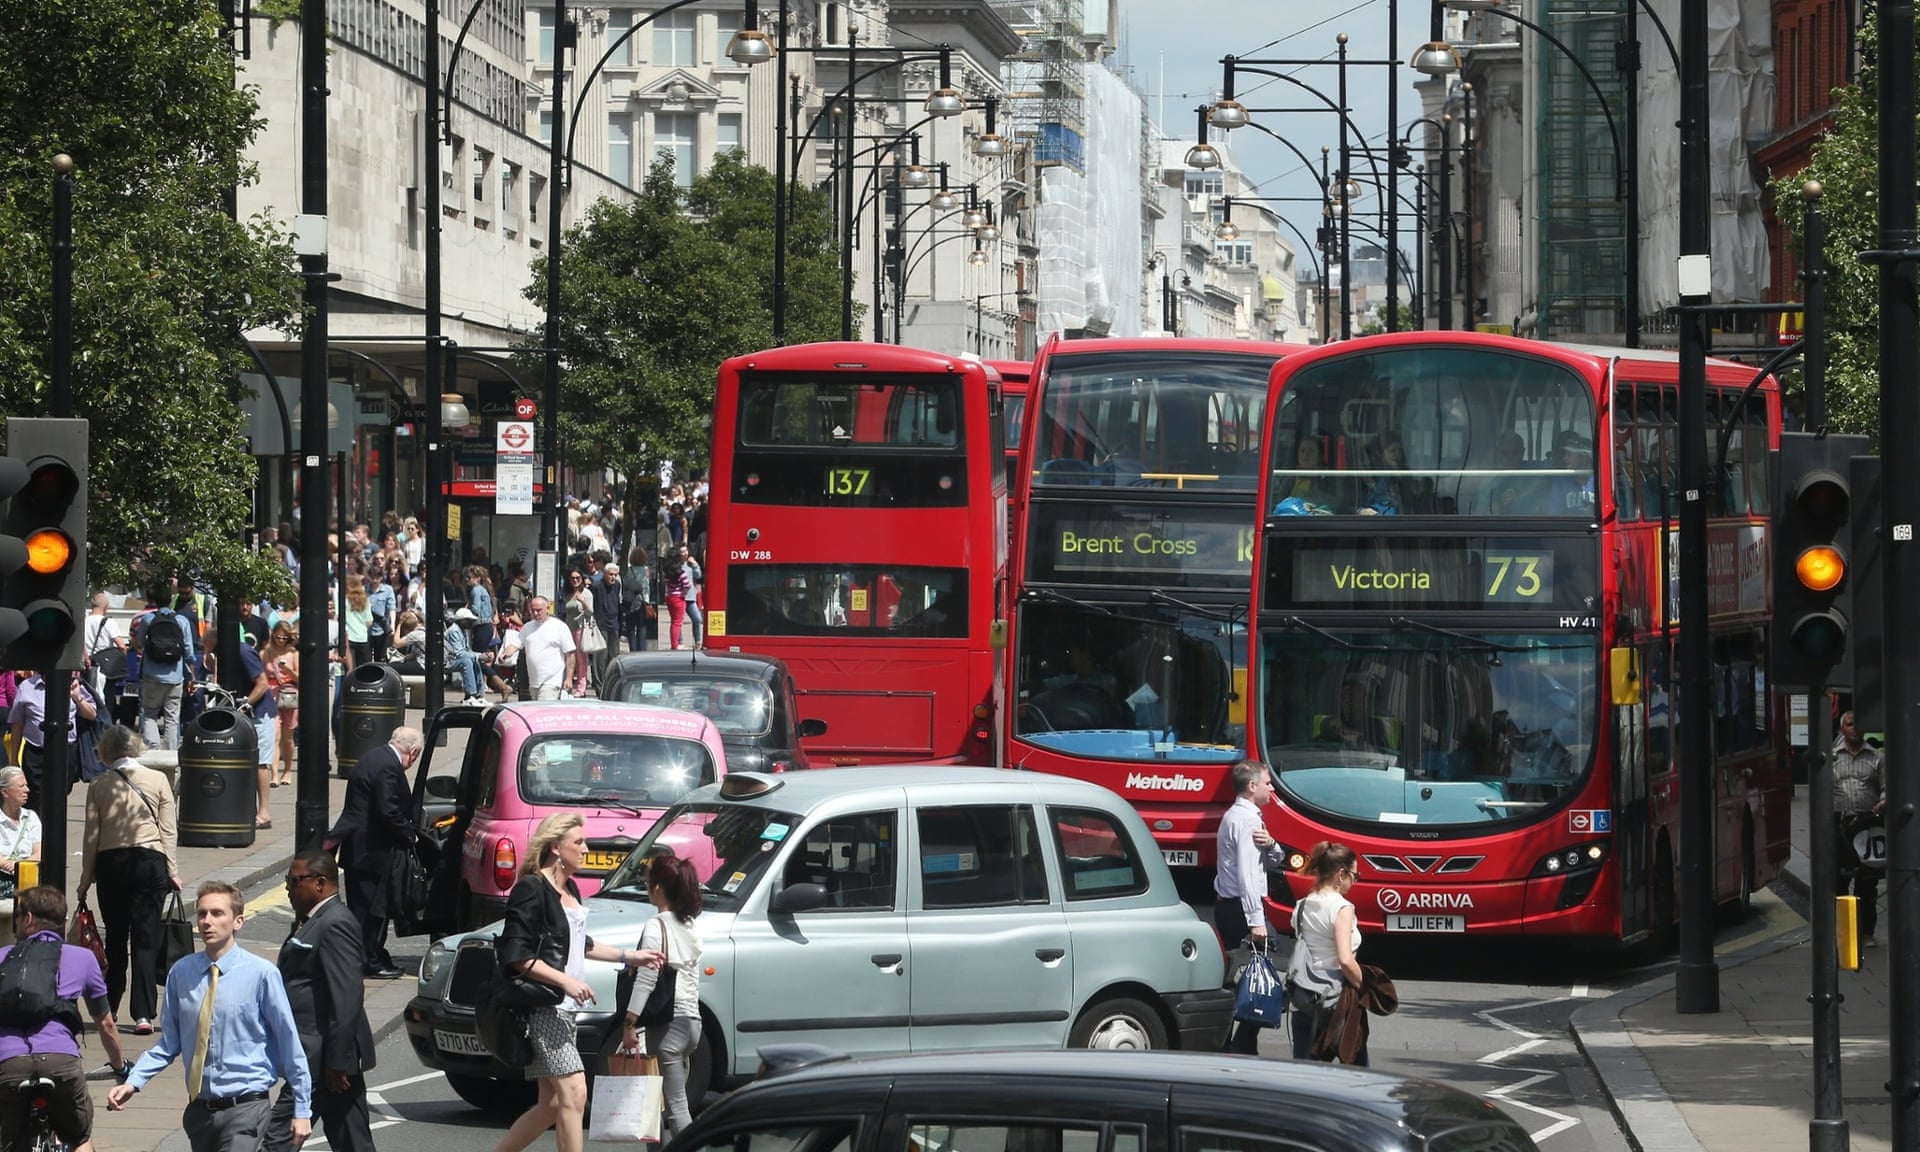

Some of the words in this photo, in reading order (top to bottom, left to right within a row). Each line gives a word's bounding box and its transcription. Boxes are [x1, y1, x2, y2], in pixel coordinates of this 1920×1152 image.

[518, 405, 533, 414] OF
[829, 469, 870, 495] 137
[1895, 526, 1909, 538] 169
[1062, 531, 1123, 553] Brent
[1133, 532, 1197, 555] Cross
[731, 551, 750, 560] DW
[754, 551, 771, 560] 288
[1330, 564, 1431, 589] Victoria
[1487, 556, 1541, 596] 73
[1559, 616, 1579, 628] HV
[1581, 616, 1596, 628] 41
[535, 713, 573, 723] LOVE
[577, 713, 591, 721] IS
[594, 714, 620, 722] ALL
[623, 714, 655, 723] YOU
[659, 717, 697, 729] NEED
[1125, 771, 1205, 791] Metroline
[1863, 835, 1886, 860] JD
[1169, 852, 1193, 863] AFN
[1406, 892, 1474, 908] ARRIVA
[1398, 916, 1423, 930] LJ11
[1426, 916, 1454, 930] EFM
[438, 1031, 462, 1050] S770
